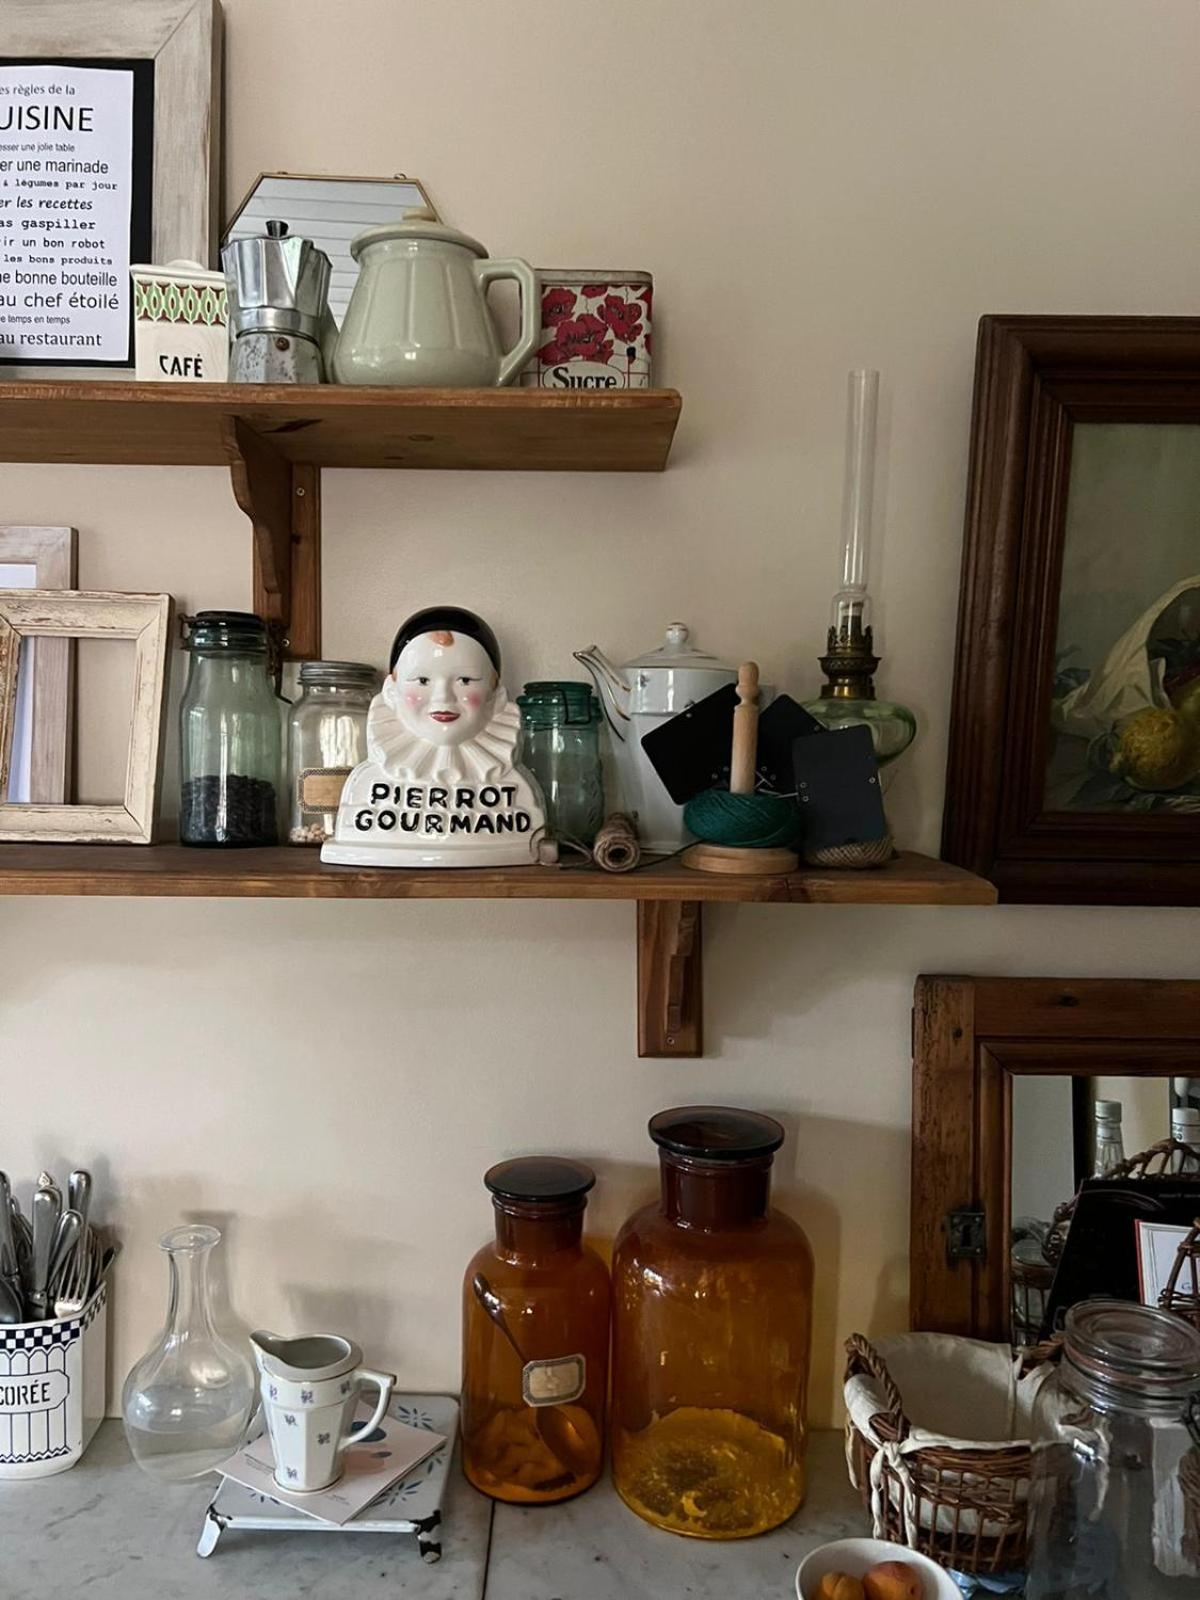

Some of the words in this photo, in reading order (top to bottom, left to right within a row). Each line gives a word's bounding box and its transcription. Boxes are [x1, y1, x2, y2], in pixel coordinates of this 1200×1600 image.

[13, 84, 45, 97] règles
[48, 84, 62, 95] de
[66, 85, 76, 96] la
[21, 143, 35, 153] une
[37, 142, 53, 154] jolie
[56, 142, 75, 153] table
[17, 160, 41, 172] une
[46, 158, 109, 175] marinade
[65, 181, 85, 190] par
[92, 181, 118, 191] jour
[16, 195, 33, 209] les
[38, 199, 93, 210] recettes
[21, 218, 96, 232] gaspiller
[22, 239, 37, 247] un
[43, 237, 64, 248] bon
[71, 239, 105, 249] robot
[4, 254, 22, 263] les
[29, 255, 55, 264] bons
[61, 256, 112, 266] produits
[15, 269, 57, 285] bonne
[61, 271, 118, 287] bouteille
[24, 292, 63, 308] chef
[68, 292, 119, 310] étoilé
[8, 314, 32, 324] temps
[46, 315, 71, 325] temps
[20, 332, 102, 346] restaurant
[159, 353, 203, 378] CAFÉ
[552, 366, 617, 388] Sucre
[371, 783, 516, 808] PIERROT
[355, 809, 531, 834] GOURMAND
